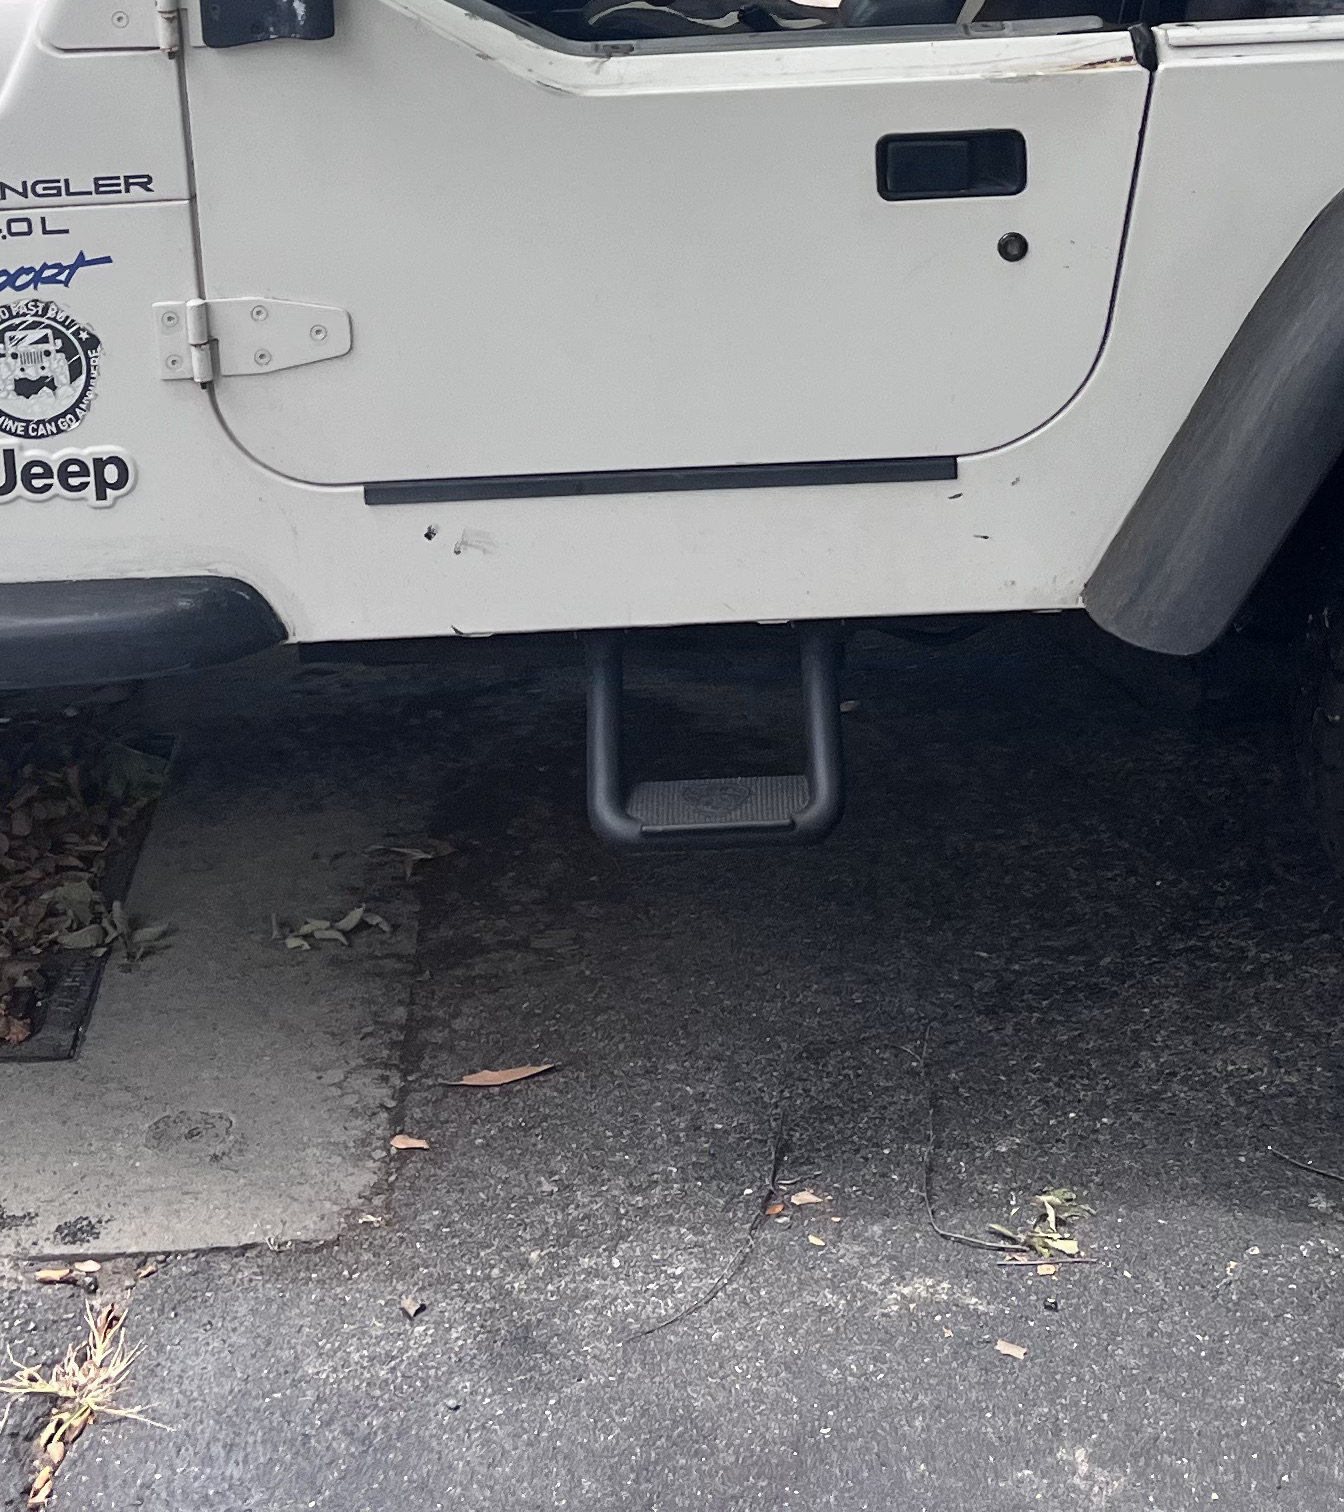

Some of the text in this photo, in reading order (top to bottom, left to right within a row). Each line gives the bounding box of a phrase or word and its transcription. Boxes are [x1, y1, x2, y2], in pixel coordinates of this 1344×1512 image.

[10, 299, 45, 316] FAST
[28, 422, 57, 437] CAN
[57, 413, 77, 430] GO
